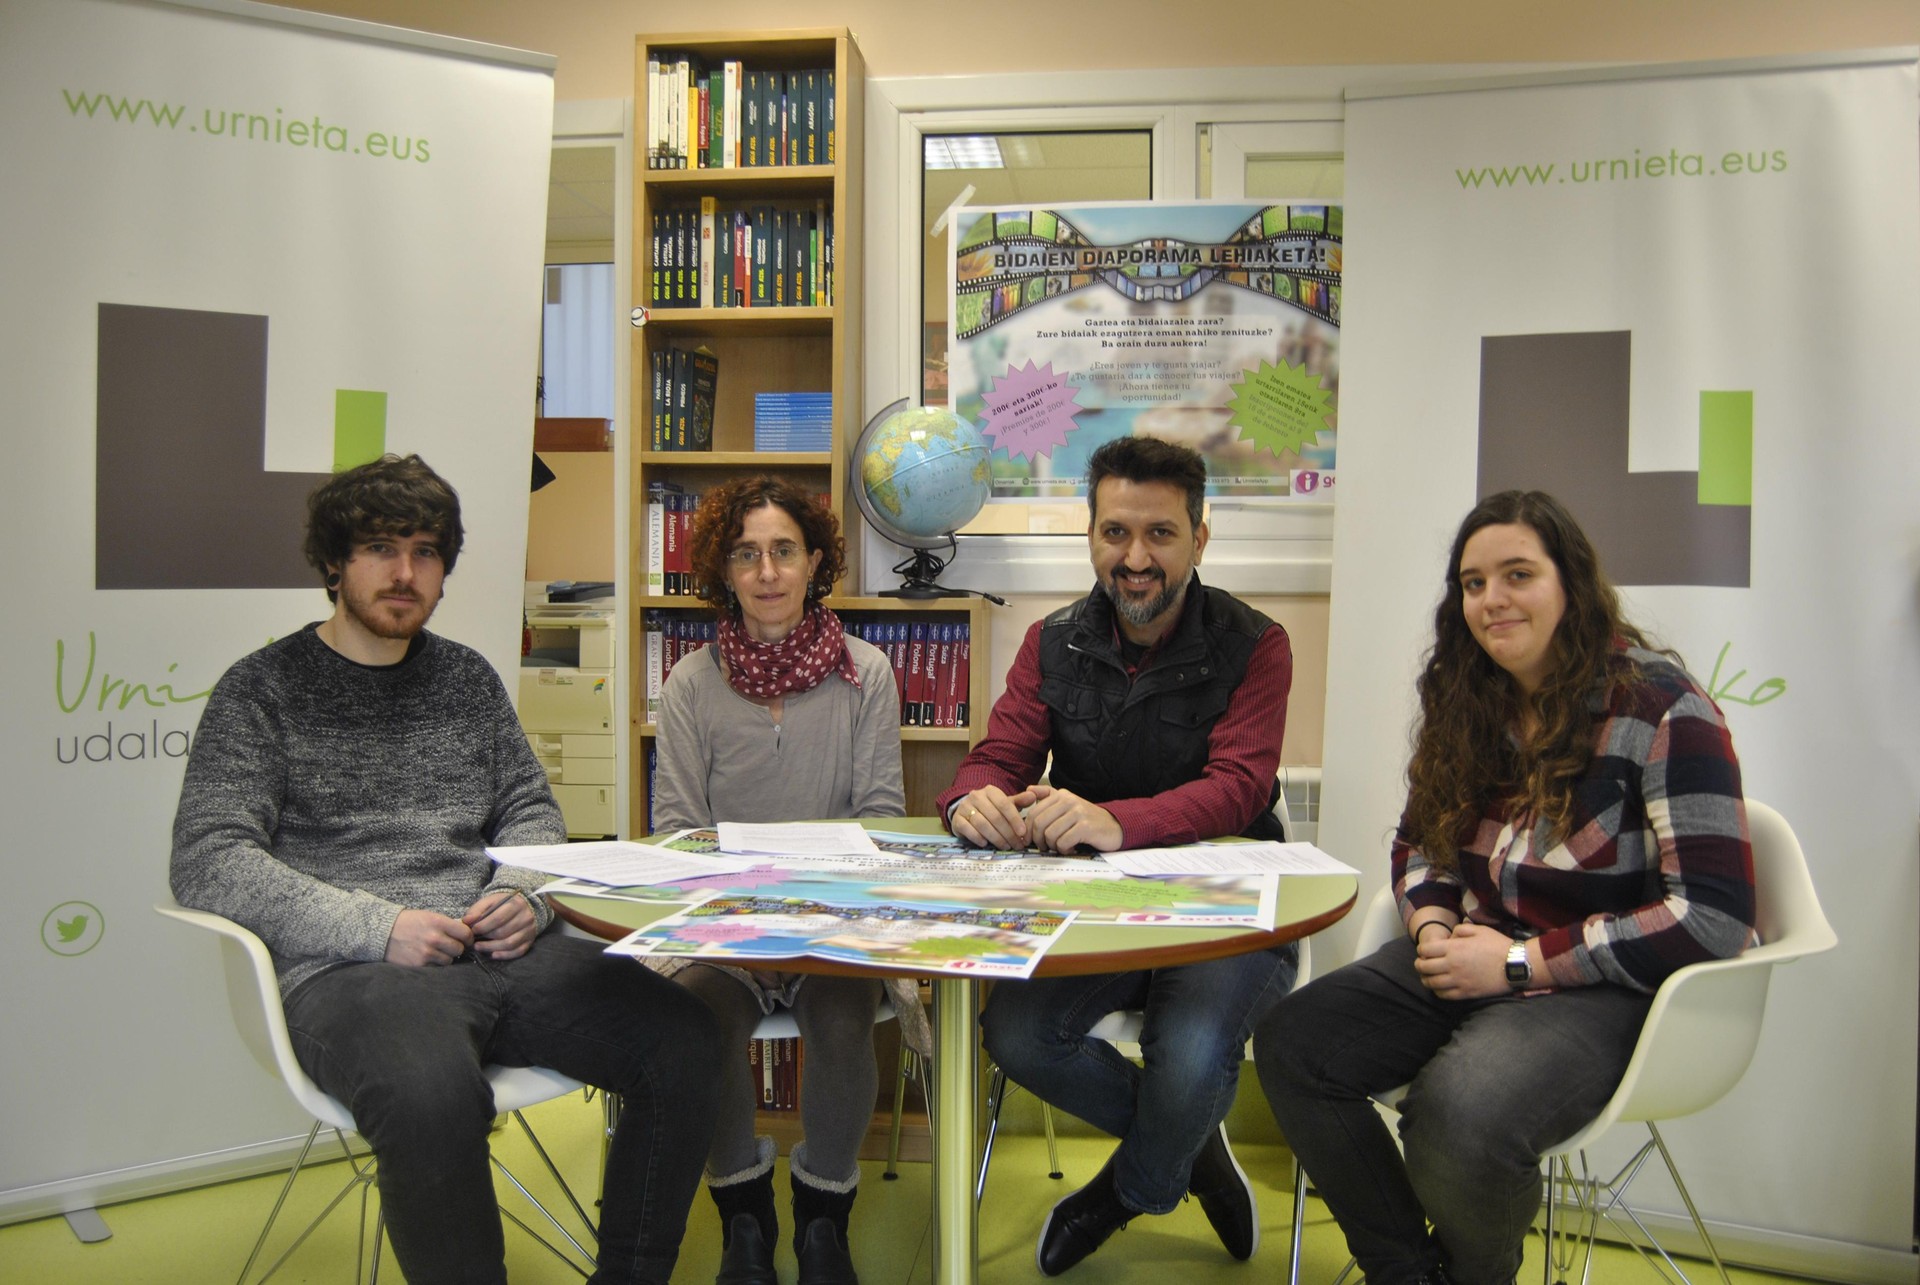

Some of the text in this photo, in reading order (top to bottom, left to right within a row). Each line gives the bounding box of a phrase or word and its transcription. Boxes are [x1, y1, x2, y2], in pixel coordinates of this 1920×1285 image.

[62, 88, 430, 163] www.urnieta.eus
[1455, 148, 1787, 189] www.urnieta.eus
[994, 247, 1326, 268] BIDAIEN DIAPORAMA LEHIAKETA!
[1138, 318, 1195, 326] bidaiazalea
[1061, 330, 1098, 338] bidaiak
[1100, 331, 1153, 339] ezagutzera
[1221, 328, 1273, 336] zenituzke?
[1102, 340, 1113, 348] Ba
[1116, 340, 1141, 348] orain
[1117, 362, 1141, 370] joven
[1163, 362, 1188, 370] gusta
[1128, 372, 1143, 380] dar
[1012, 397, 1025, 406] eta
[1014, 398, 1044, 416] sariak!
[1122, 393, 1181, 402] oportunidad!
[1035, 410, 1046, 418] de
[652, 510, 660, 567] ALEMANIA
[669, 514, 677, 552] Alemania
[665, 639, 673, 671] Londres
[897, 644, 906, 668] Suecia
[912, 644, 921, 674] Polonia
[926, 644, 937, 679] Portugal
[57, 719, 189, 764] udala
